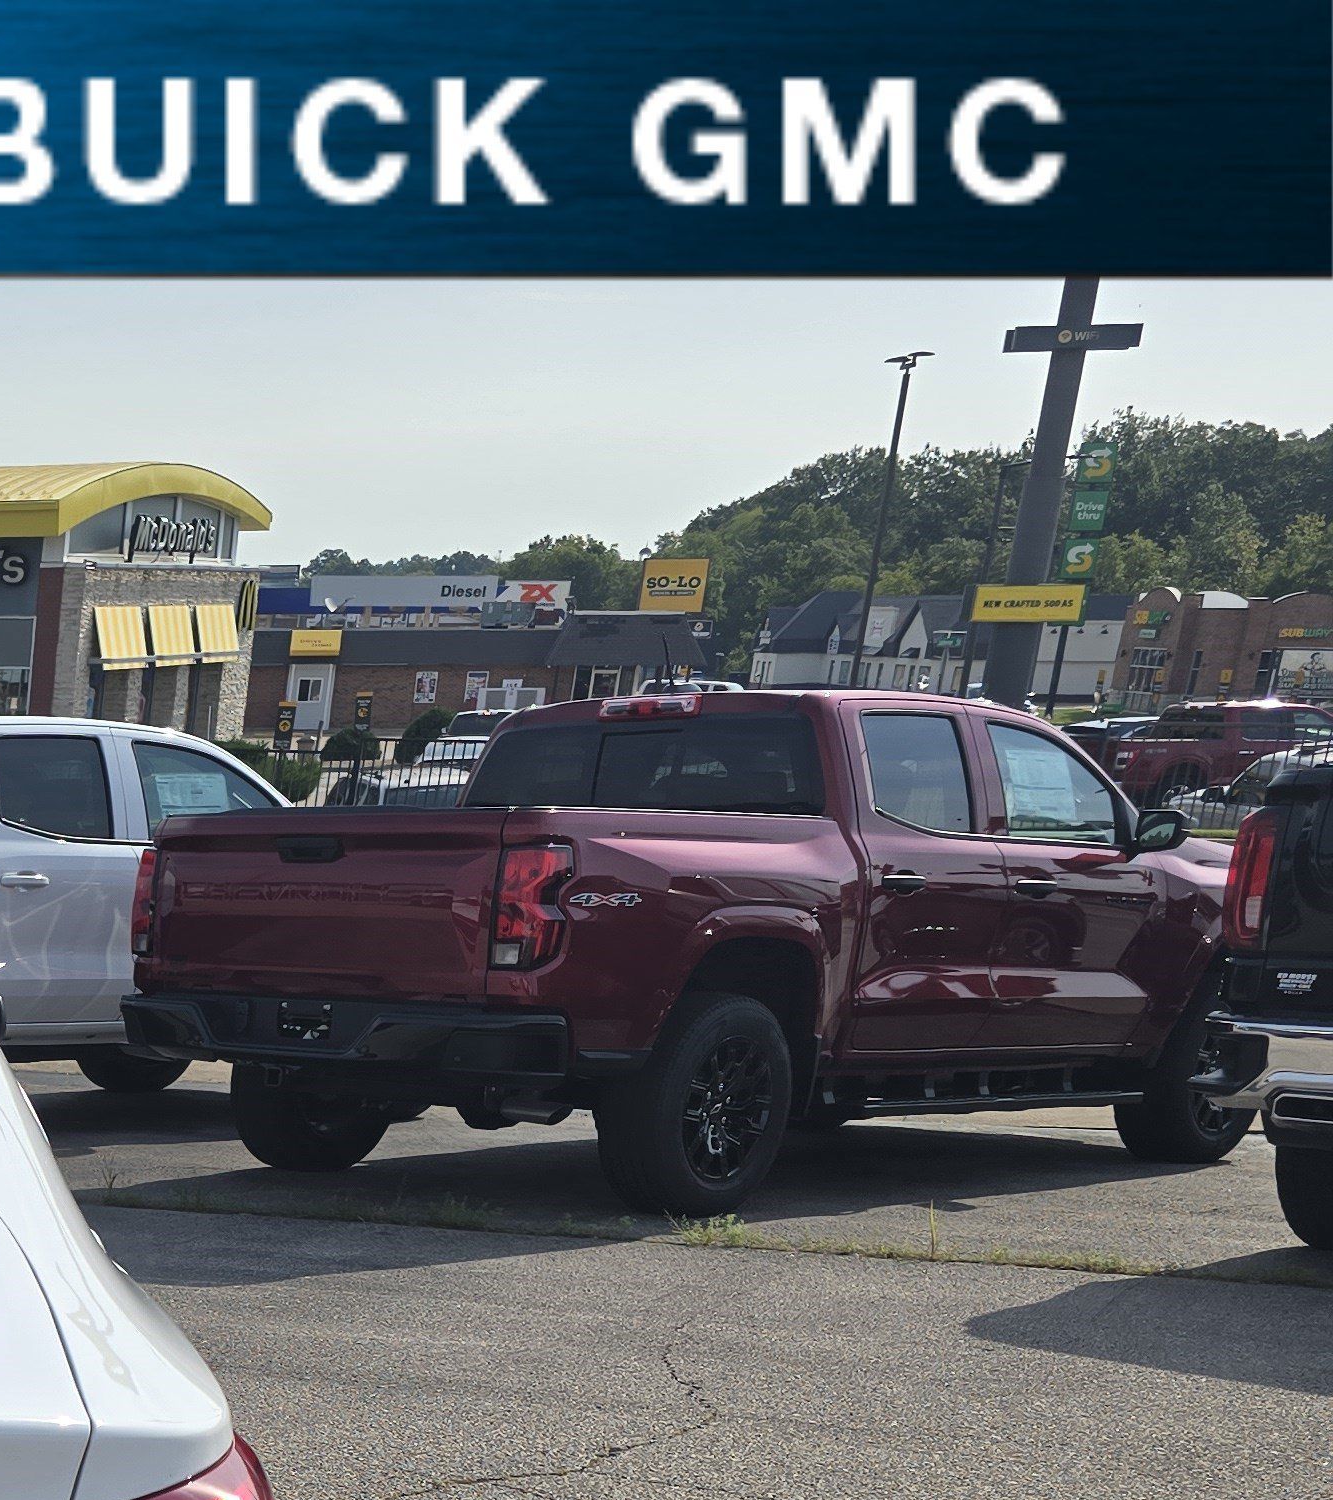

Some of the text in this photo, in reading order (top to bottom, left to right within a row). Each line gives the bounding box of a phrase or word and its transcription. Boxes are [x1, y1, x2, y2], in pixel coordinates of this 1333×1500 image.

[1076, 501, 1104, 511] Drive
[1077, 510, 1101, 520] thru
[134, 515, 217, 552] McDonald's
[646, 575, 702, 589] SO-LO
[440, 584, 487, 599] Diesel
[983, 600, 1002, 608] NEW
[1004, 600, 1042, 608] CRAFTED
[1279, 627, 1333, 638] SUBWAY
